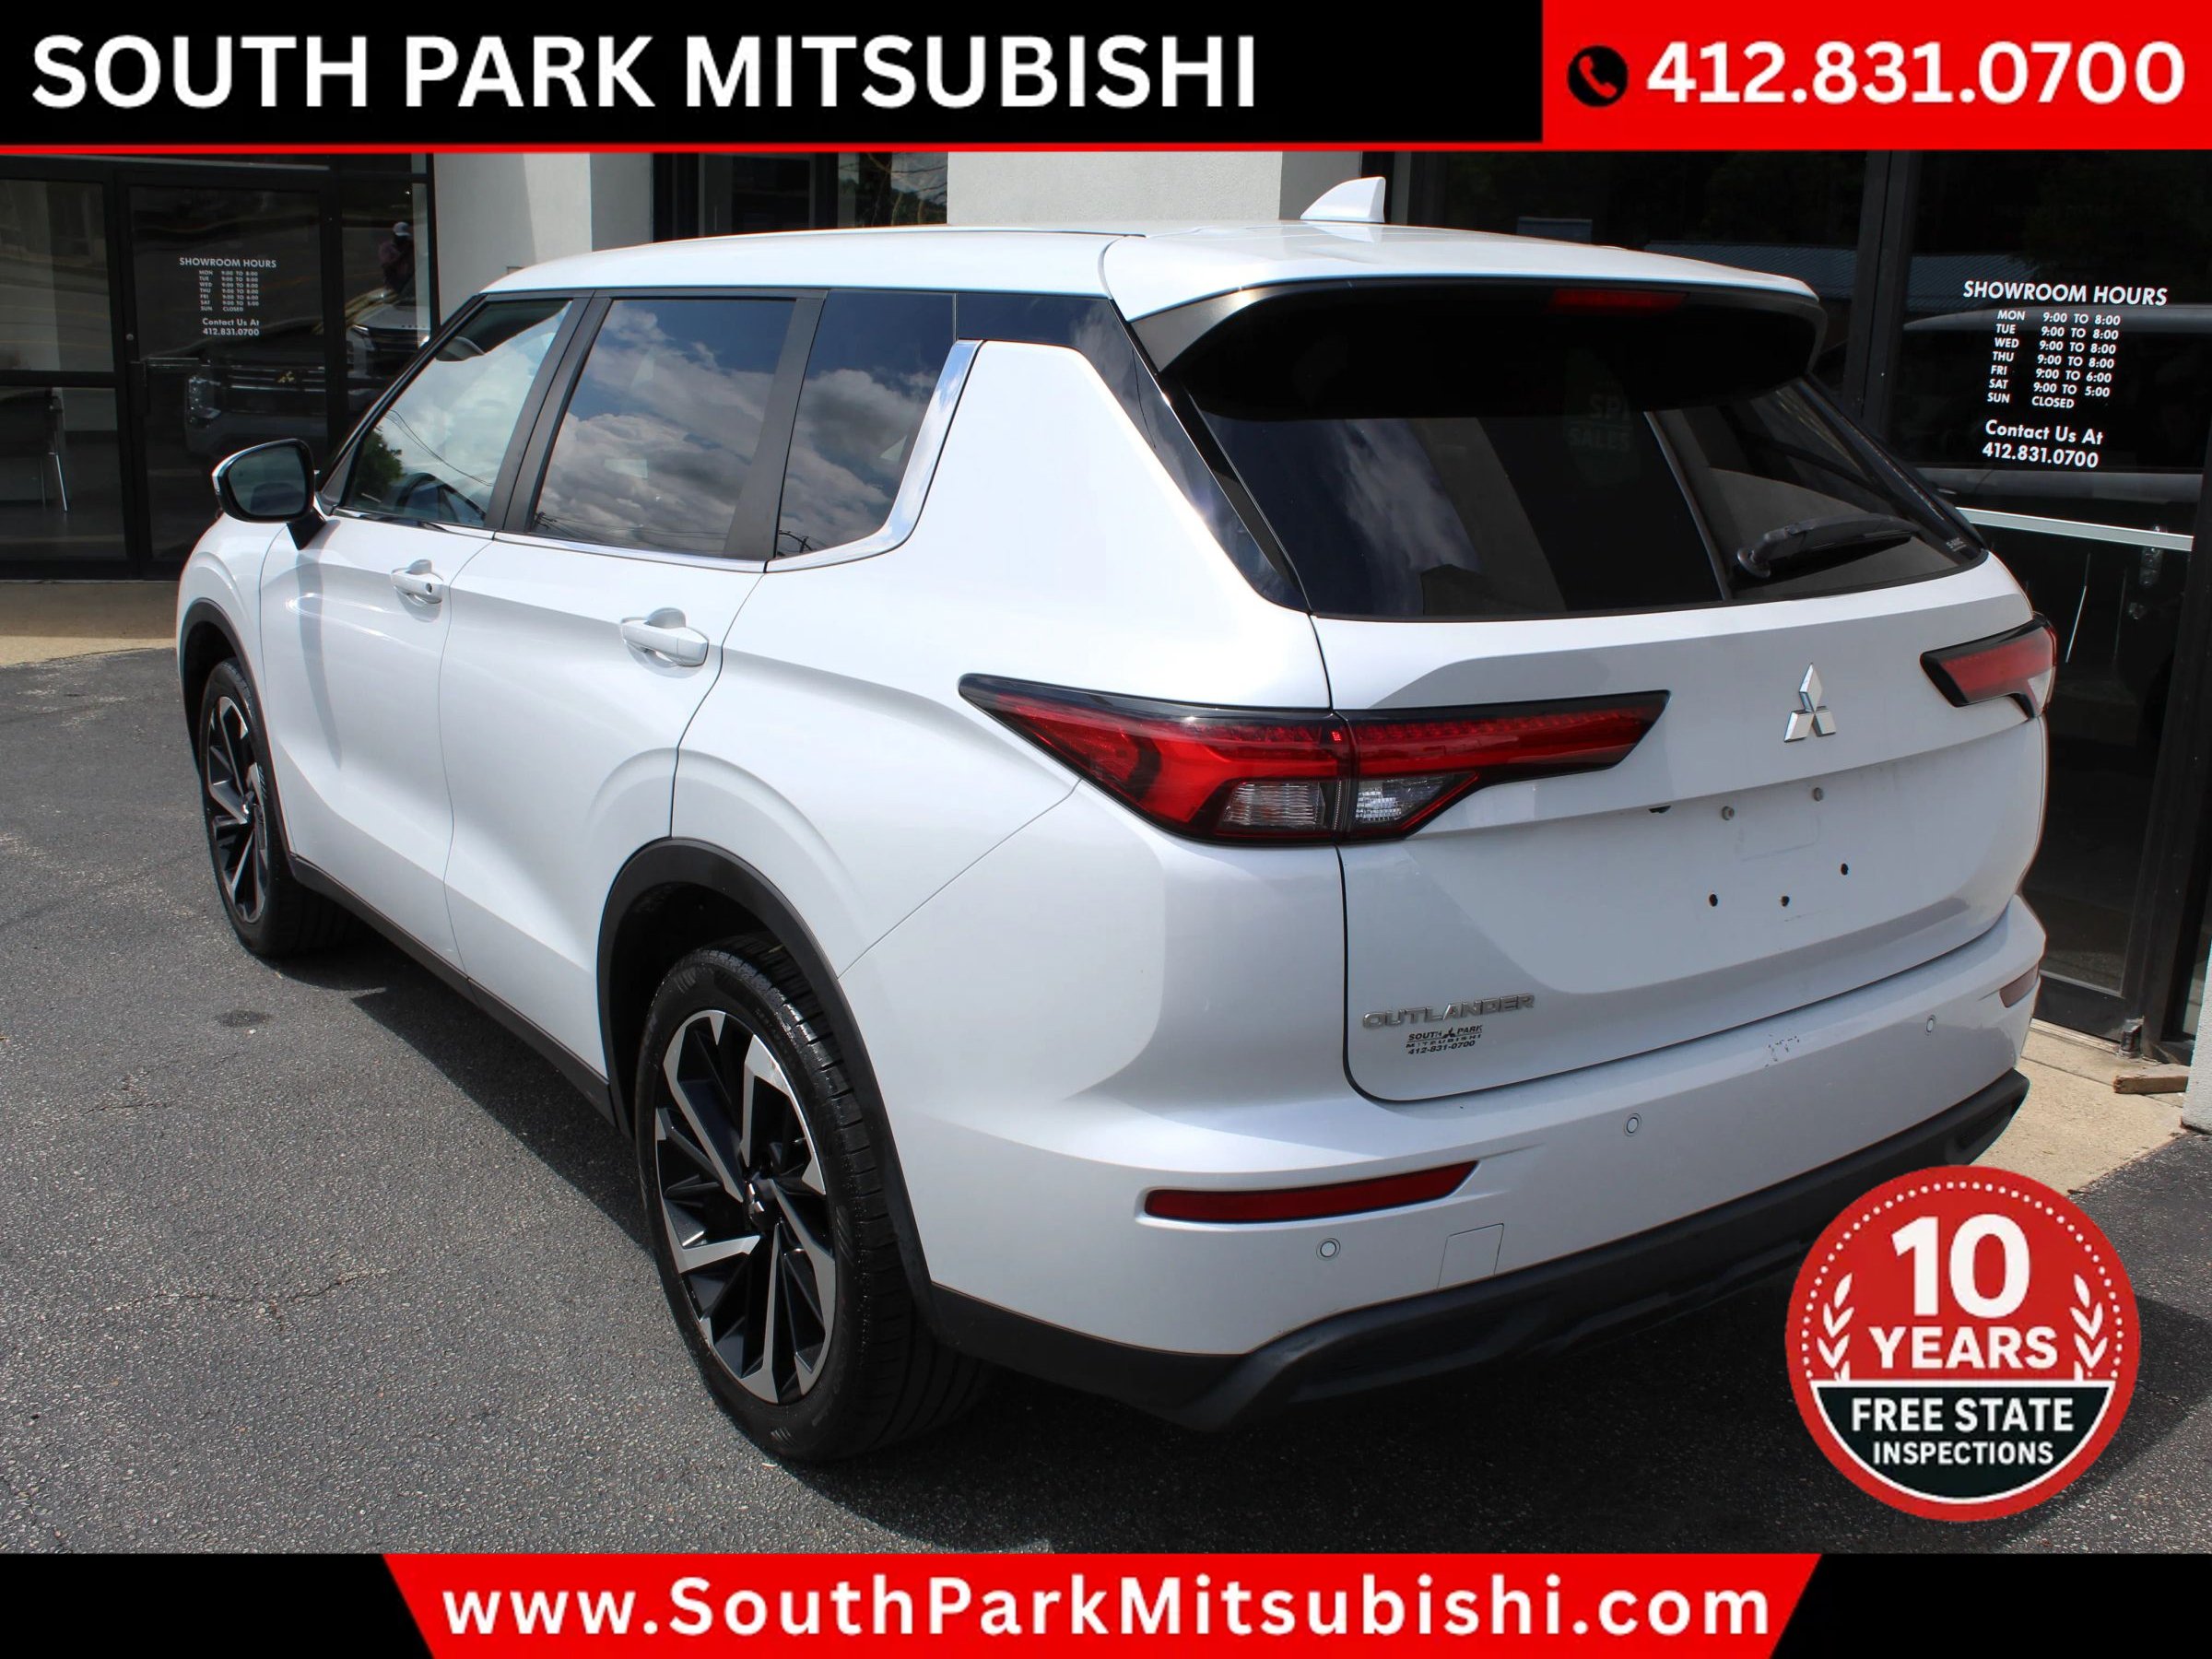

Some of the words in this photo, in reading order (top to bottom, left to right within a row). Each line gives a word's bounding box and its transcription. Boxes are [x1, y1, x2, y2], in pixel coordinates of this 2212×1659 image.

[179, 257, 241, 267] SHOWROOM
[242, 259, 277, 268] HOURS
[1963, 280, 2087, 302] SHOWROOM
[2093, 287, 2168, 306] HOURS
[1996, 310, 2026, 321] MON
[2042, 312, 2067, 323] 9:00
[2074, 313, 2088, 324] TO
[2094, 314, 2121, 325] 8:00
[203, 328, 260, 336] 412.831.0700
[1996, 324, 2016, 335] TUE
[2041, 326, 2065, 337] 9:00
[2071, 328, 2086, 338] TO
[2092, 329, 2119, 340] 8:00
[1994, 337, 2019, 348] WED
[2039, 340, 2064, 351] 9:00
[2070, 342, 2085, 352] TO
[2090, 343, 2116, 354] 8:00
[1993, 351, 2014, 361] THU
[2037, 354, 2062, 365] 9:00
[2067, 356, 2083, 367] TO
[2088, 358, 2114, 369] 8:00
[1991, 365, 2007, 376] FRI
[2035, 369, 2059, 380] 9:00
[2065, 371, 2080, 381] TO
[2086, 371, 2112, 383] 6:00
[1989, 379, 2008, 390] SAT
[2033, 382, 2057, 394] 9:00
[2062, 383, 2077, 394] TO
[2085, 386, 2111, 397] 5:00
[1987, 393, 2010, 404] SUN
[2031, 396, 2075, 408] CLOSED
[1985, 419, 2050, 441] Contact
[2055, 426, 2077, 442] Us
[2081, 428, 2103, 445] At
[1982, 441, 2100, 468] 412.831.0700
[1362, 993, 1535, 1029] OUTLANDER
[1408, 1030, 1442, 1041] SOUTH
[1457, 1024, 1483, 1034] PARK
[1407, 1040, 1477, 1055] 412-831-0700
